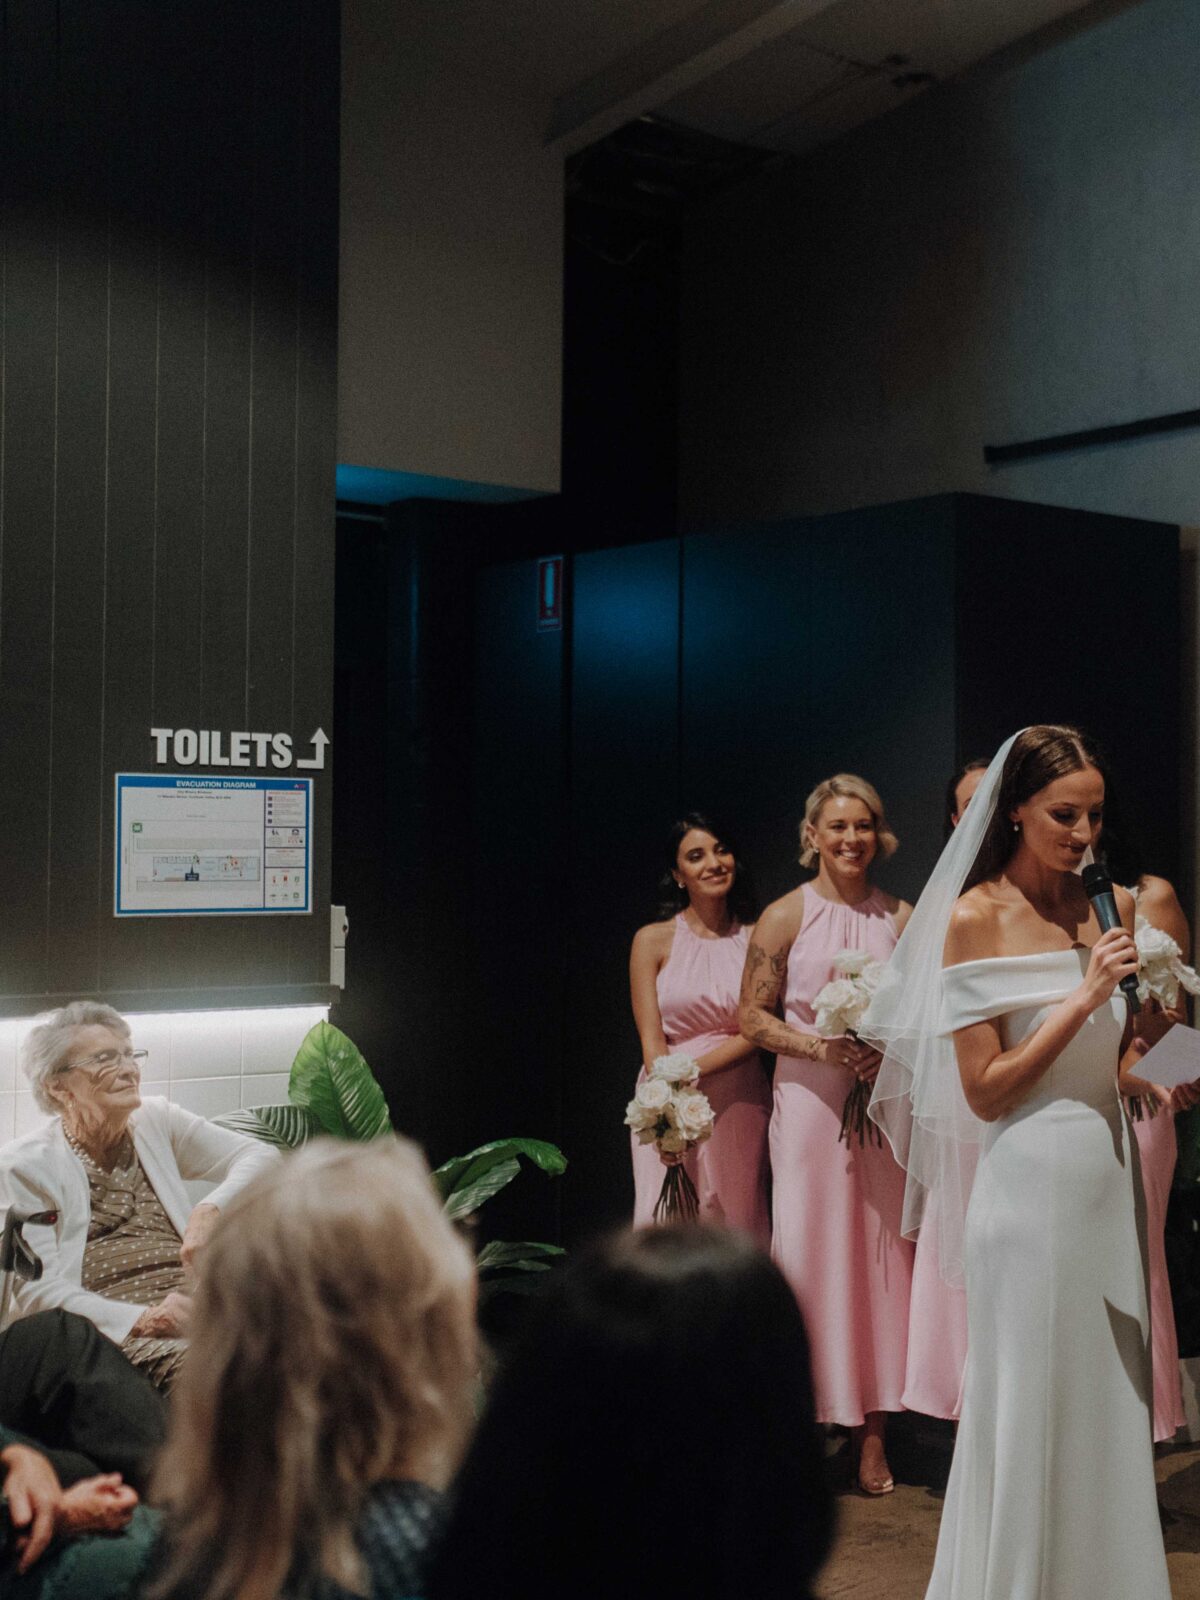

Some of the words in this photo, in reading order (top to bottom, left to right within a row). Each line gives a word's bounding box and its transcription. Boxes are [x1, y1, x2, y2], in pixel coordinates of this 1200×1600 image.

[150, 728, 293, 769] TOILETS
[176, 780, 222, 788] EVACUATION
[223, 781, 257, 789] DIAGRAM
